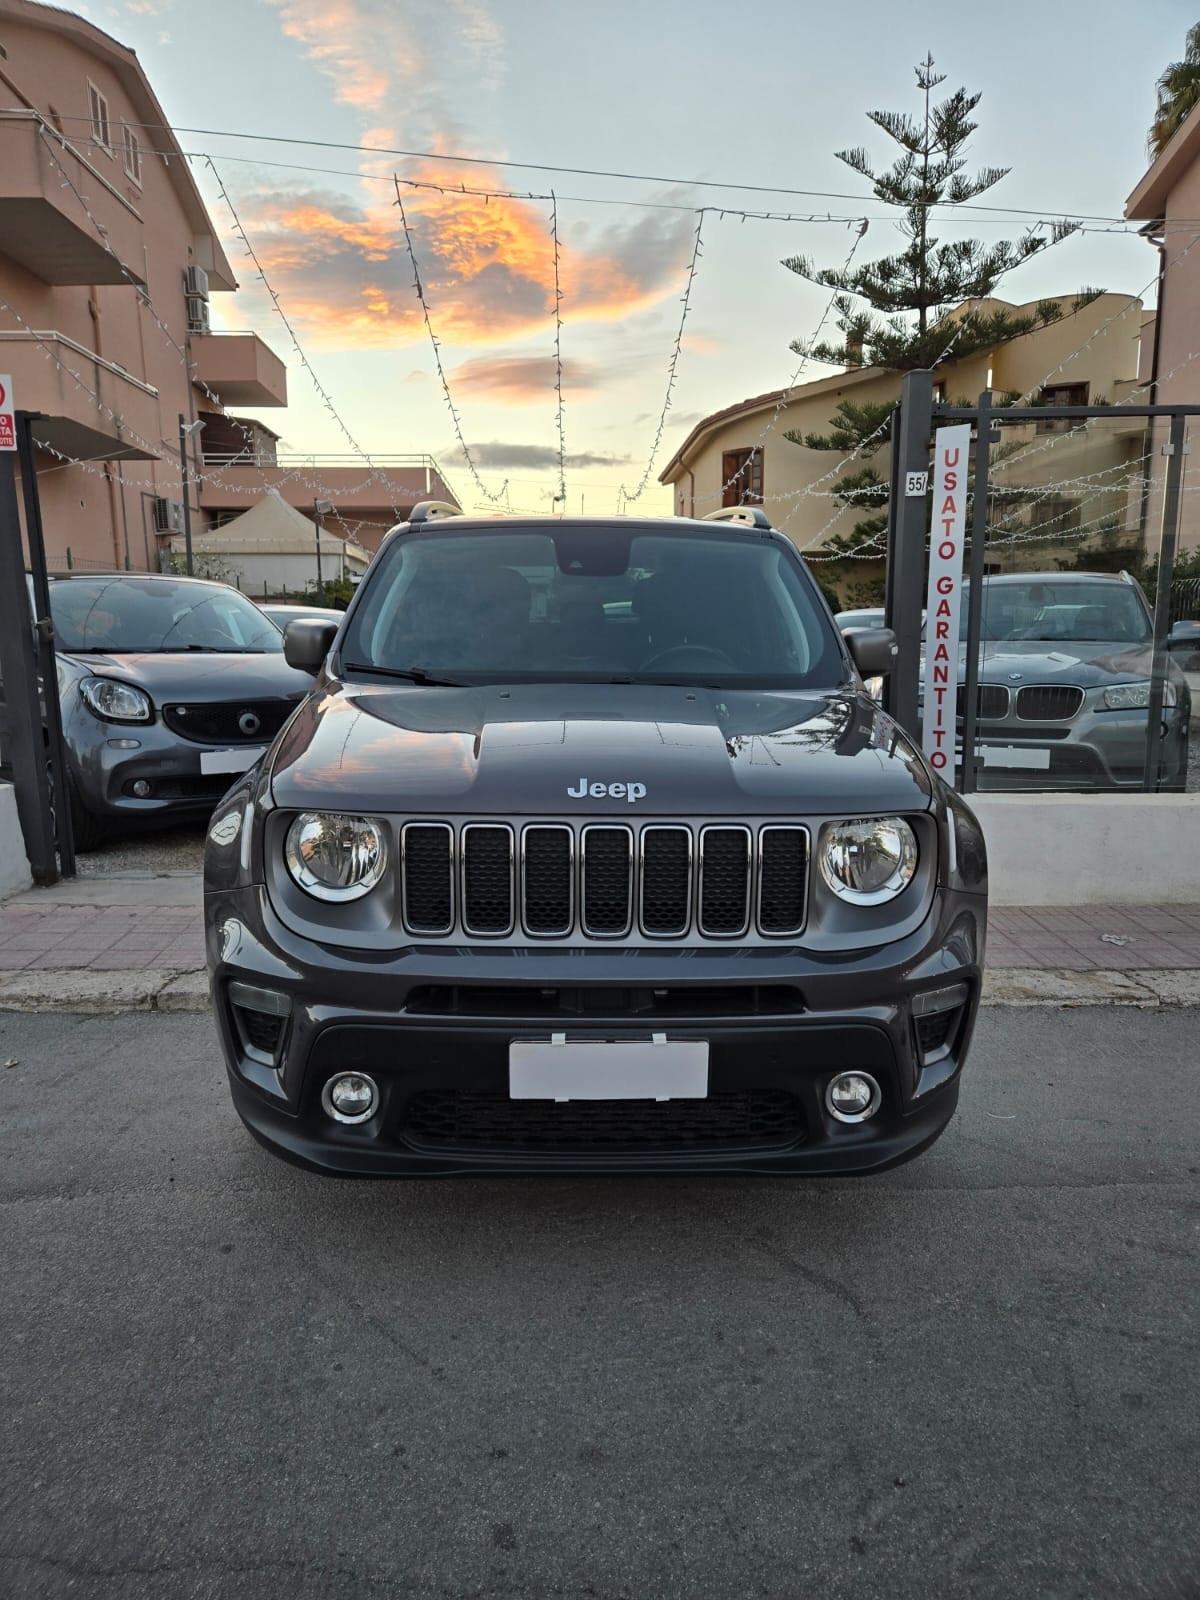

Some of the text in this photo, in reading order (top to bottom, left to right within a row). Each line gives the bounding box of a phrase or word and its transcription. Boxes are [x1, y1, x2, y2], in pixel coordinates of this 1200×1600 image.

[0, 427, 12, 436] TA
[930, 448, 959, 769] USATO GARANTITO
[567, 778, 647, 803] Jeep
